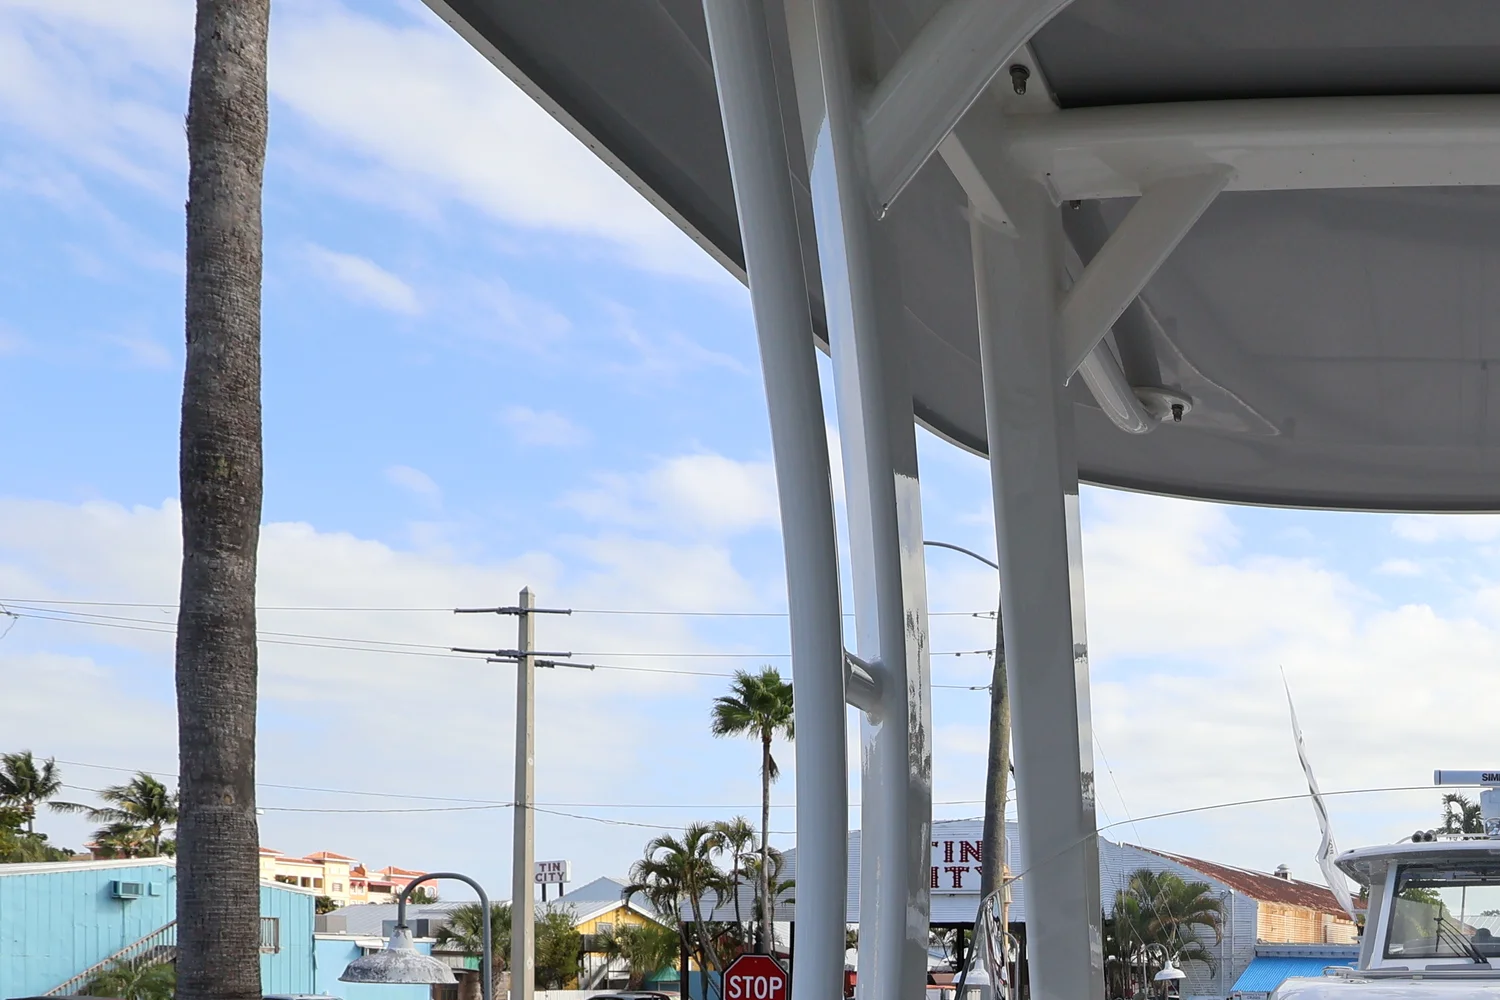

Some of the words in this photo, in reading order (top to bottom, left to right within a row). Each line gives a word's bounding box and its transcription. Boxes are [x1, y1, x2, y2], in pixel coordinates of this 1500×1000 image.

[932, 840, 983, 863] IN
[535, 872, 564, 882] CITY
[539, 863, 560, 872] TIN
[931, 867, 982, 888] IT
[729, 975, 782, 999] STOP
